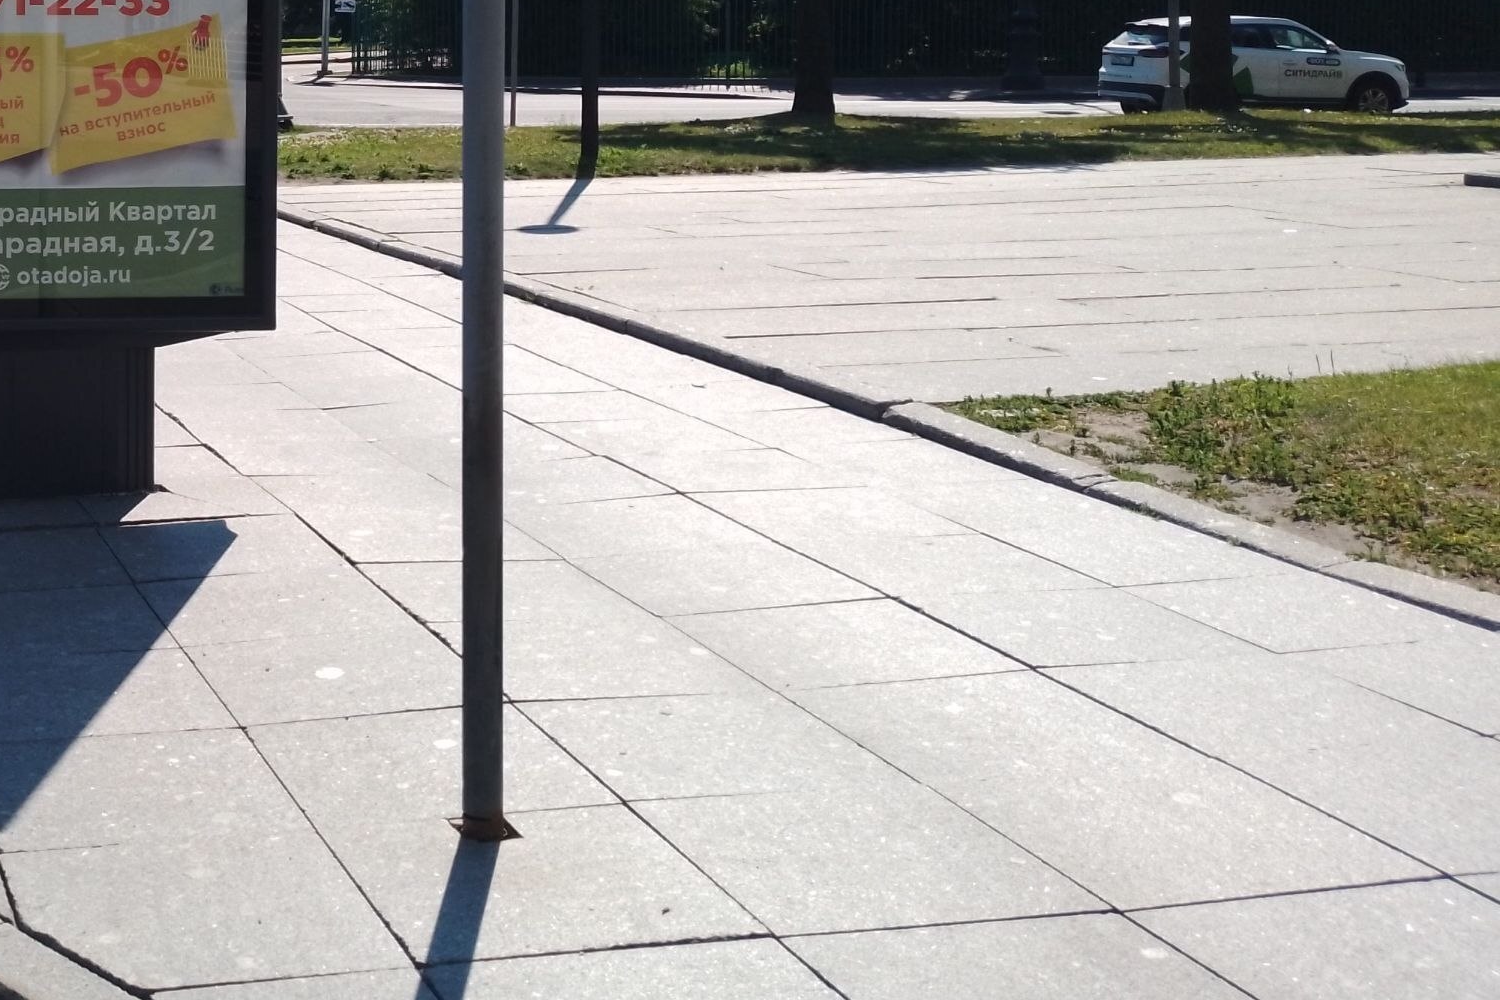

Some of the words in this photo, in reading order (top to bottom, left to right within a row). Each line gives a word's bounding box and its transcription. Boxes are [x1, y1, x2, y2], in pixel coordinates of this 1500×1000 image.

[73, 46, 189, 109] -50%
[59, 122, 80, 137] на
[84, 91, 216, 134] вступительный
[116, 120, 166, 143] взнос
[109, 201, 216, 224] Квартал
[135, 230, 215, 255] д.3/2
[16, 266, 131, 287] otadoja.ru
